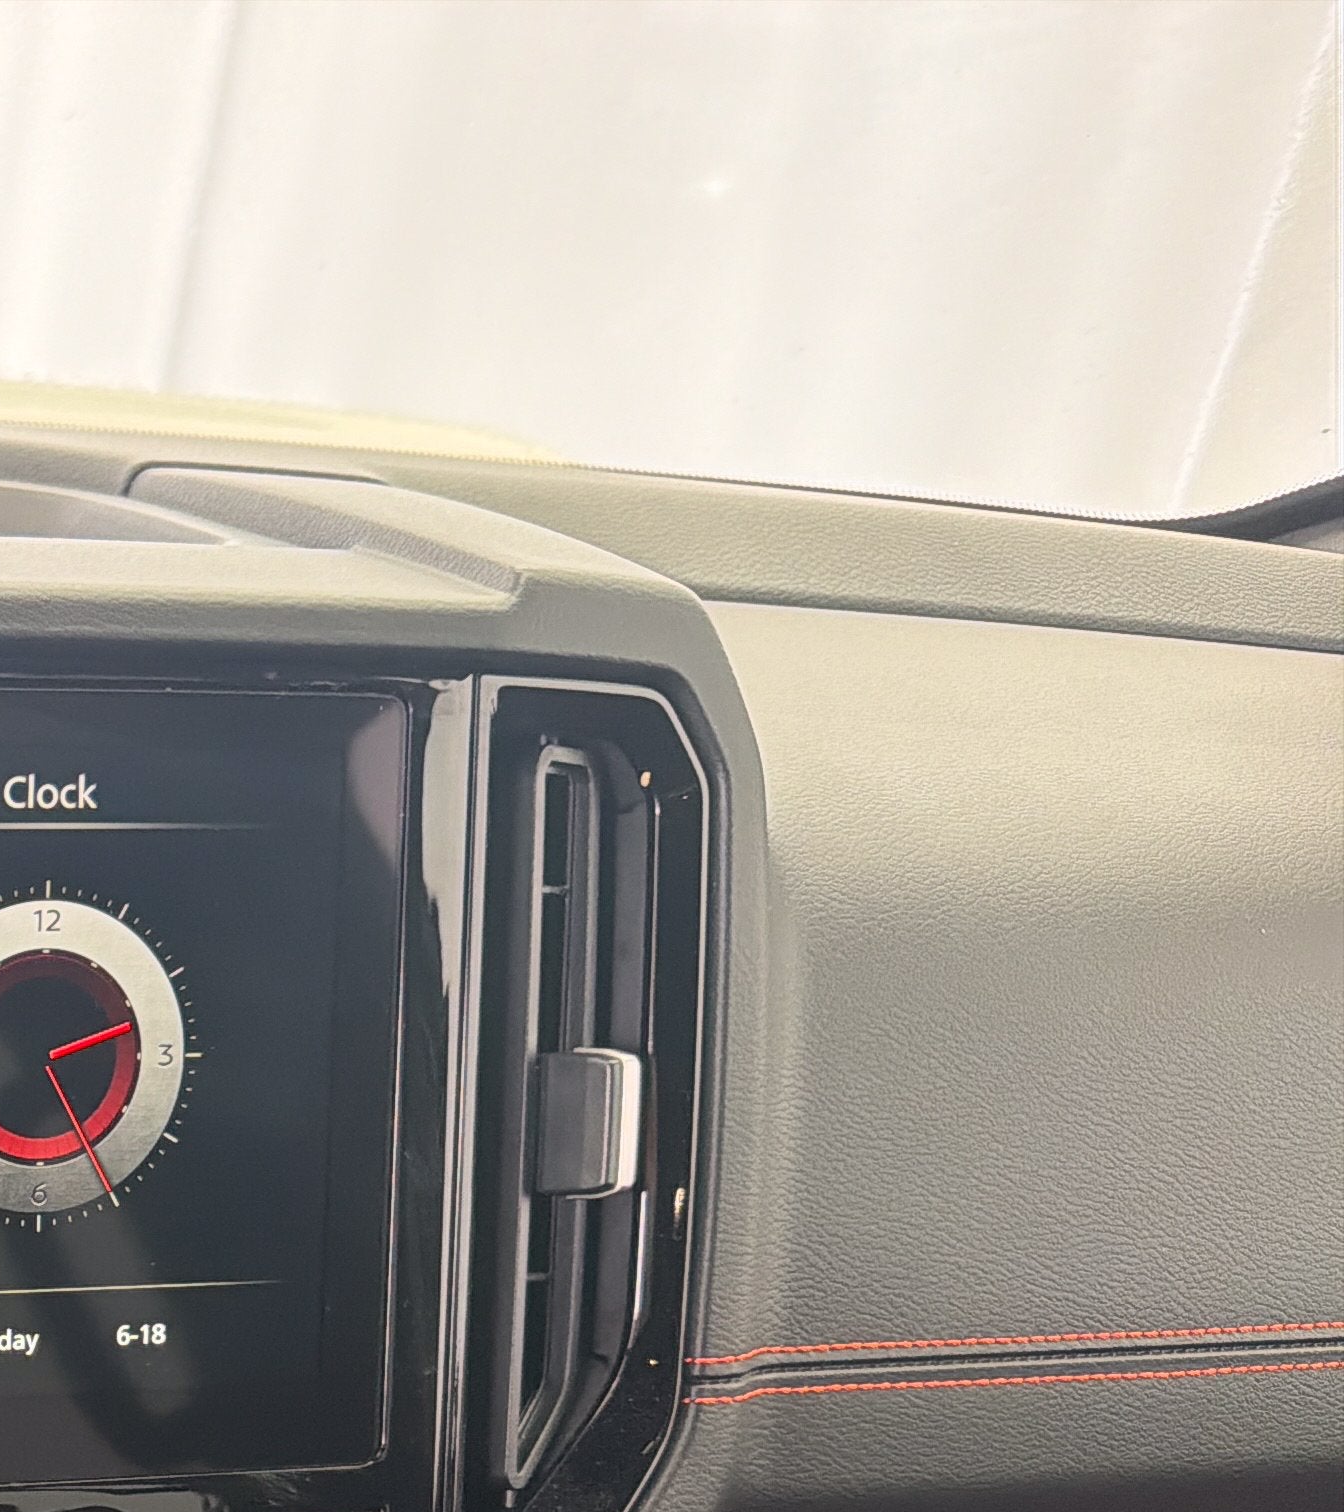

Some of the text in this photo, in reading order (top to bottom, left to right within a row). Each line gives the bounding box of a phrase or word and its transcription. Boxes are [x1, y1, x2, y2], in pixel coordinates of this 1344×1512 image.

[2, 774, 98, 810] Clock
[34, 908, 62, 934] 12
[156, 1043, 174, 1068] 3
[31, 1183, 48, 1207] 6
[115, 1323, 168, 1348] 6-18
